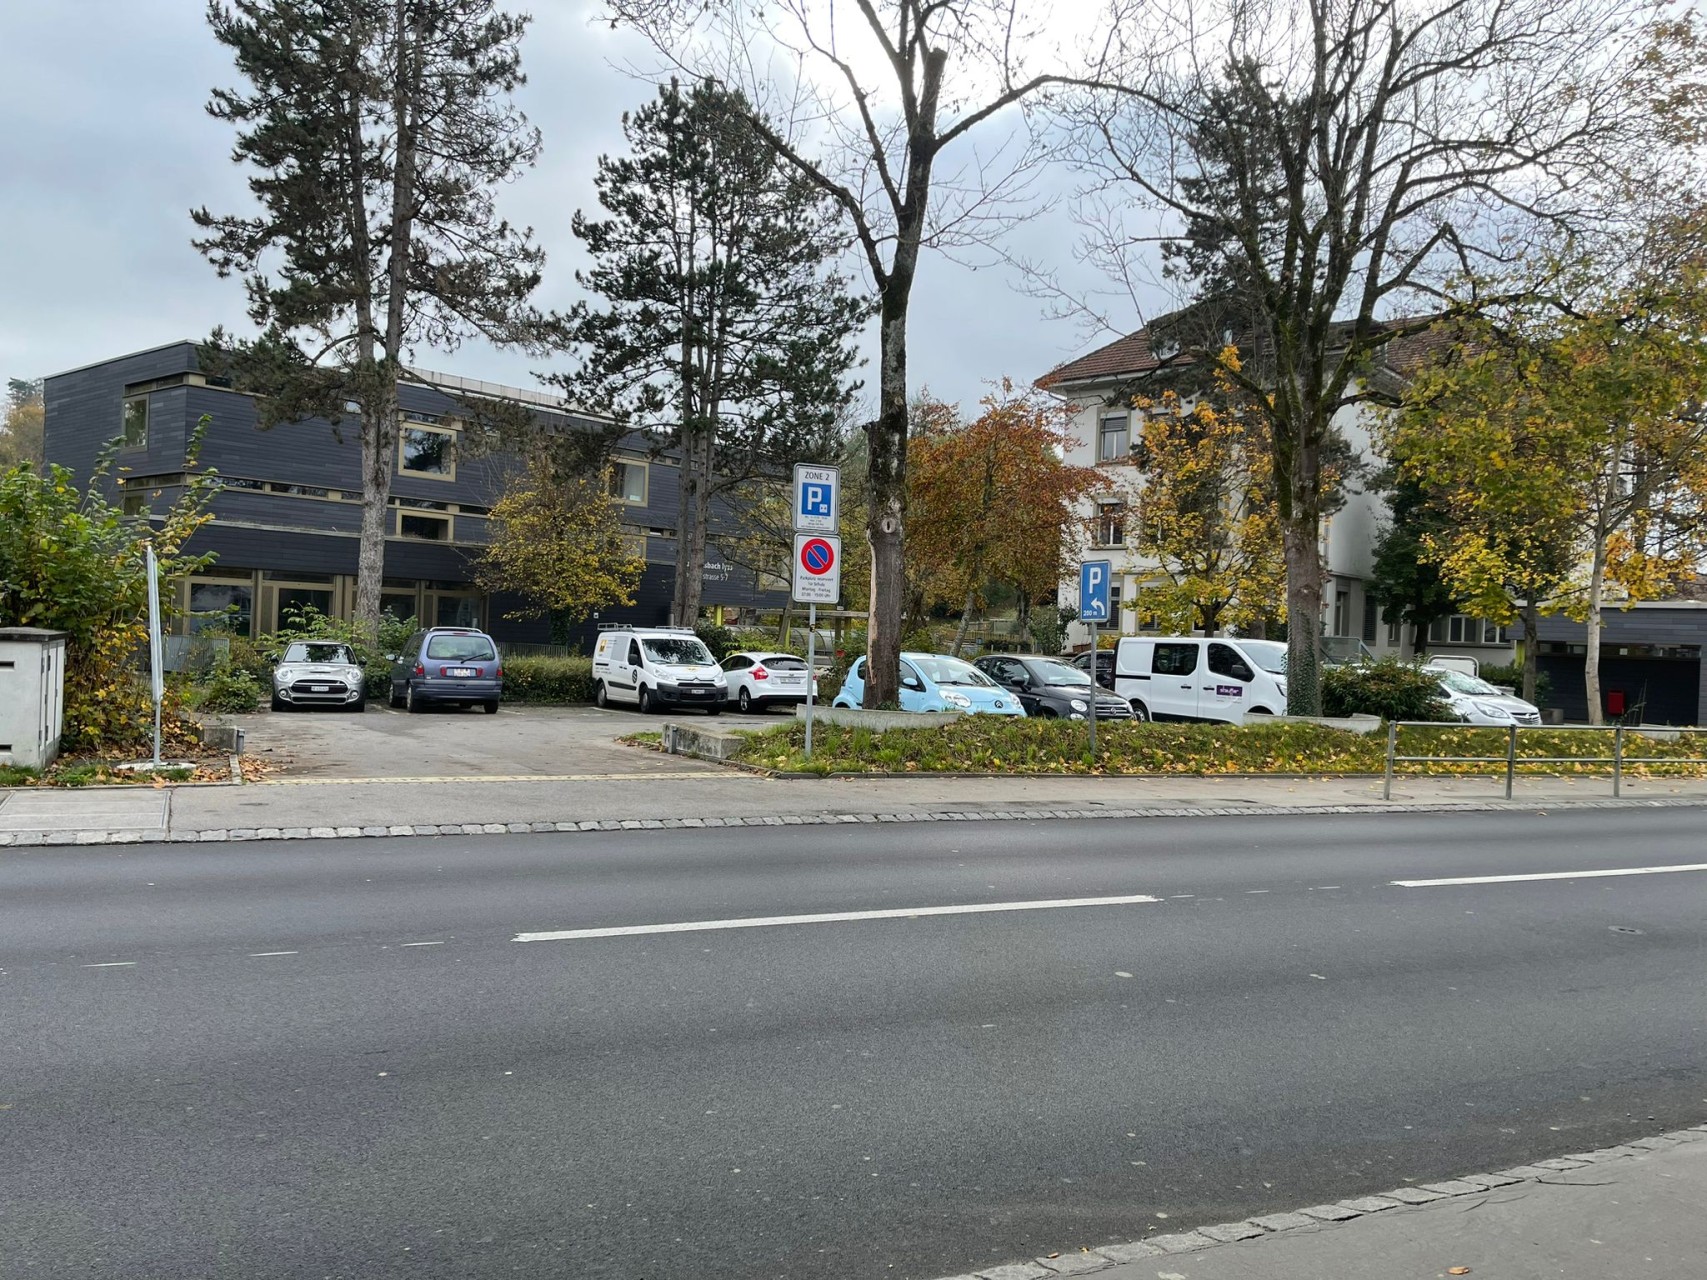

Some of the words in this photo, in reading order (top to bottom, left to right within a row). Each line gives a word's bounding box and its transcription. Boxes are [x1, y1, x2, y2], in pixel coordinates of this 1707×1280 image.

[804, 471, 823, 480] ZONE
[825, 473, 830, 481] 2
[807, 486, 823, 510] P
[1089, 567, 1102, 594] P
